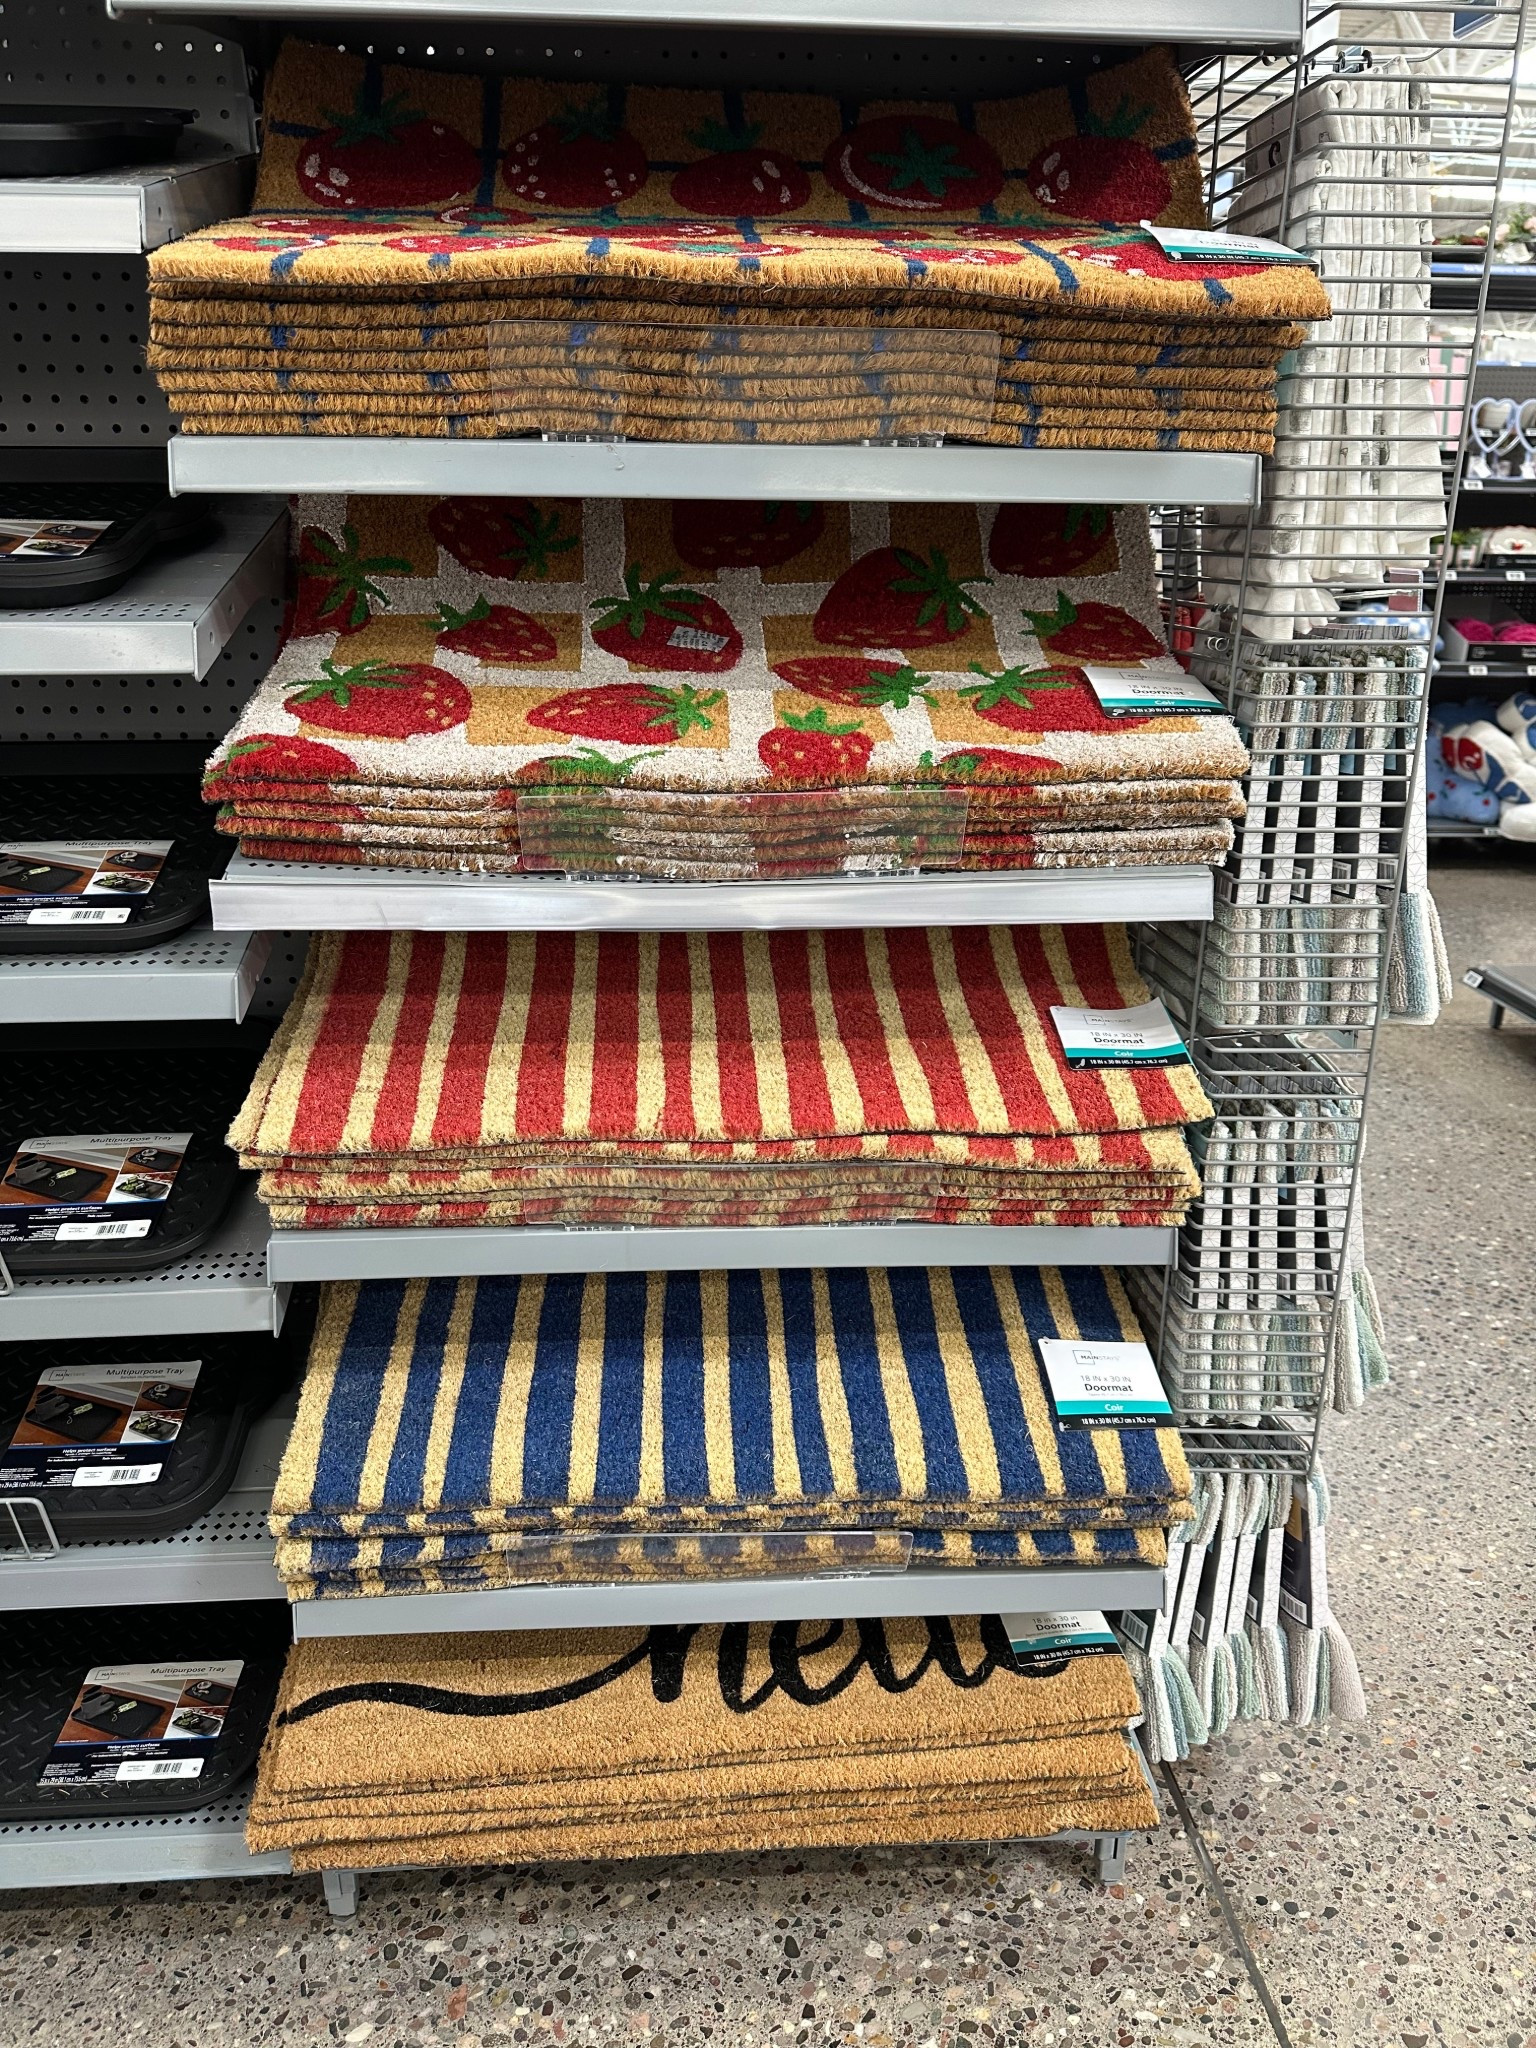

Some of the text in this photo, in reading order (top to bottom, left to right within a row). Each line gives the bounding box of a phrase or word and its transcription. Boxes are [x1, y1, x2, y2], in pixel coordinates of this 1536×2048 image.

[90, 1136, 151, 1144] Multipurpose
[1084, 1383, 1133, 1392] Doormat
[1104, 1403, 1124, 1411] Coir
[1036, 1621, 1082, 1631] Doormat
